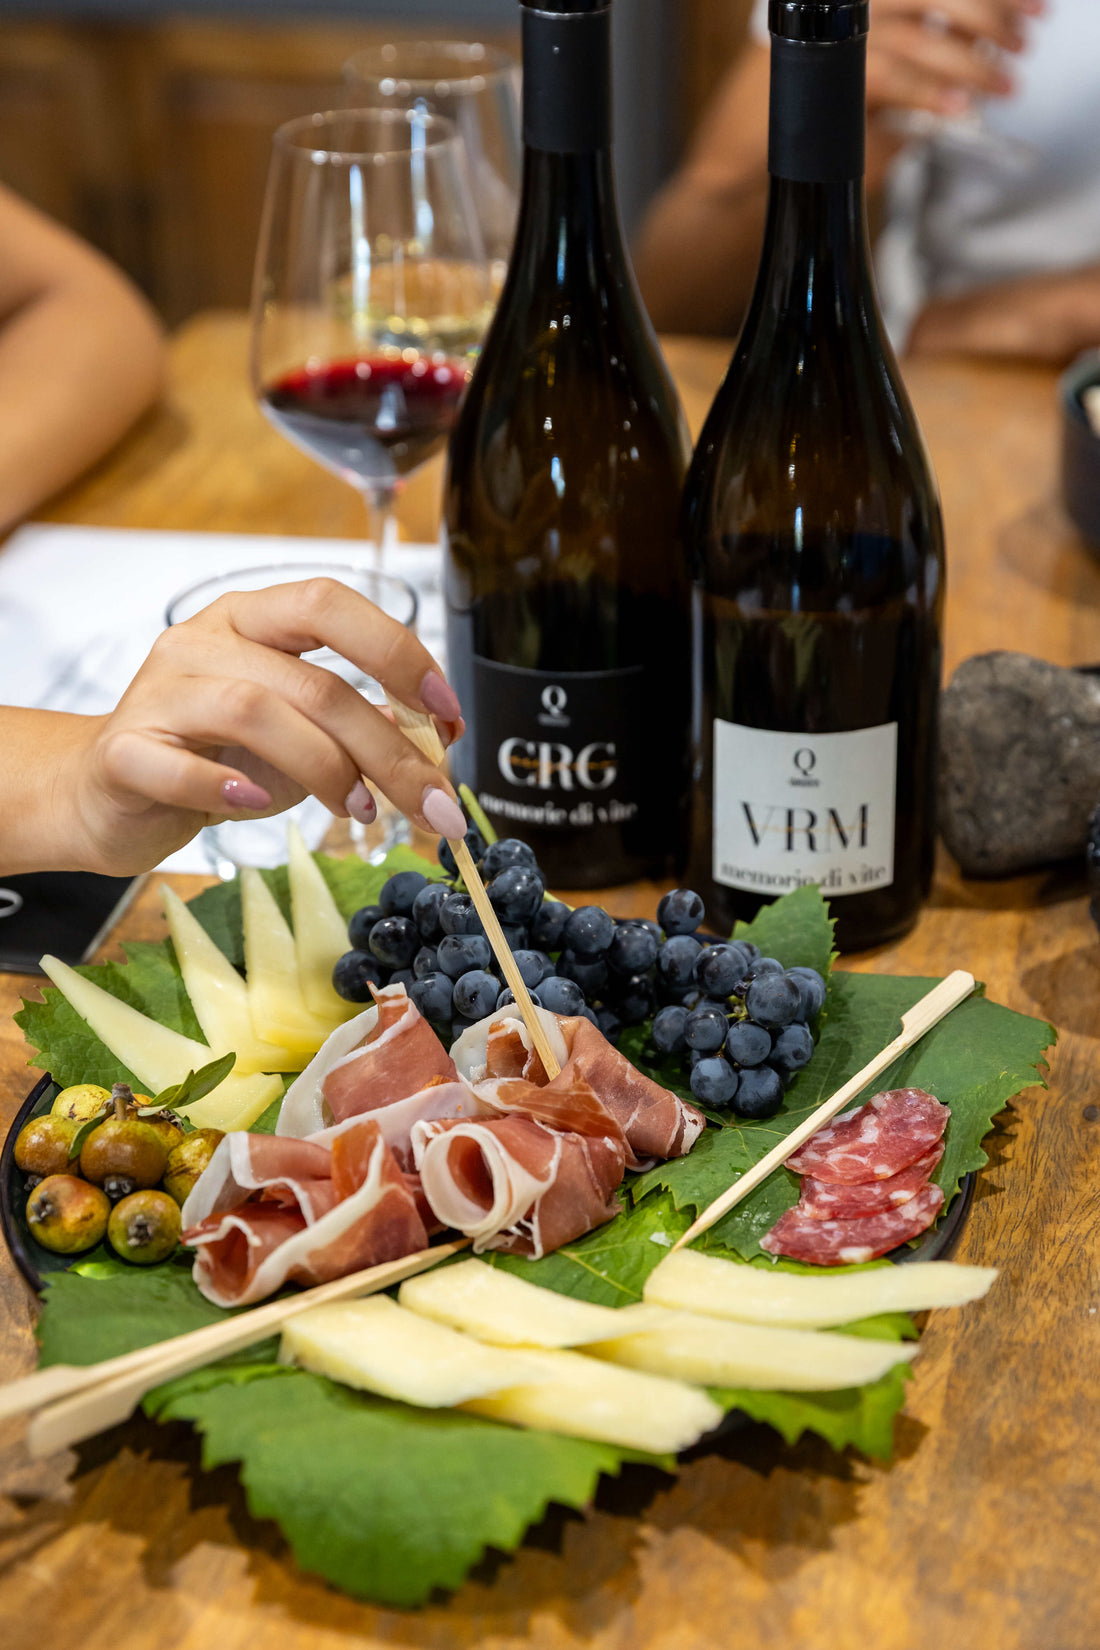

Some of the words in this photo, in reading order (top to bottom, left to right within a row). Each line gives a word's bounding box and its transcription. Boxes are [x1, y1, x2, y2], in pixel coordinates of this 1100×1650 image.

[541, 685, 568, 716] Q
[793, 747, 817, 776] Q
[569, 801, 594, 826] di
[740, 801, 868, 853] VRM
[849, 864, 887, 886] vite
